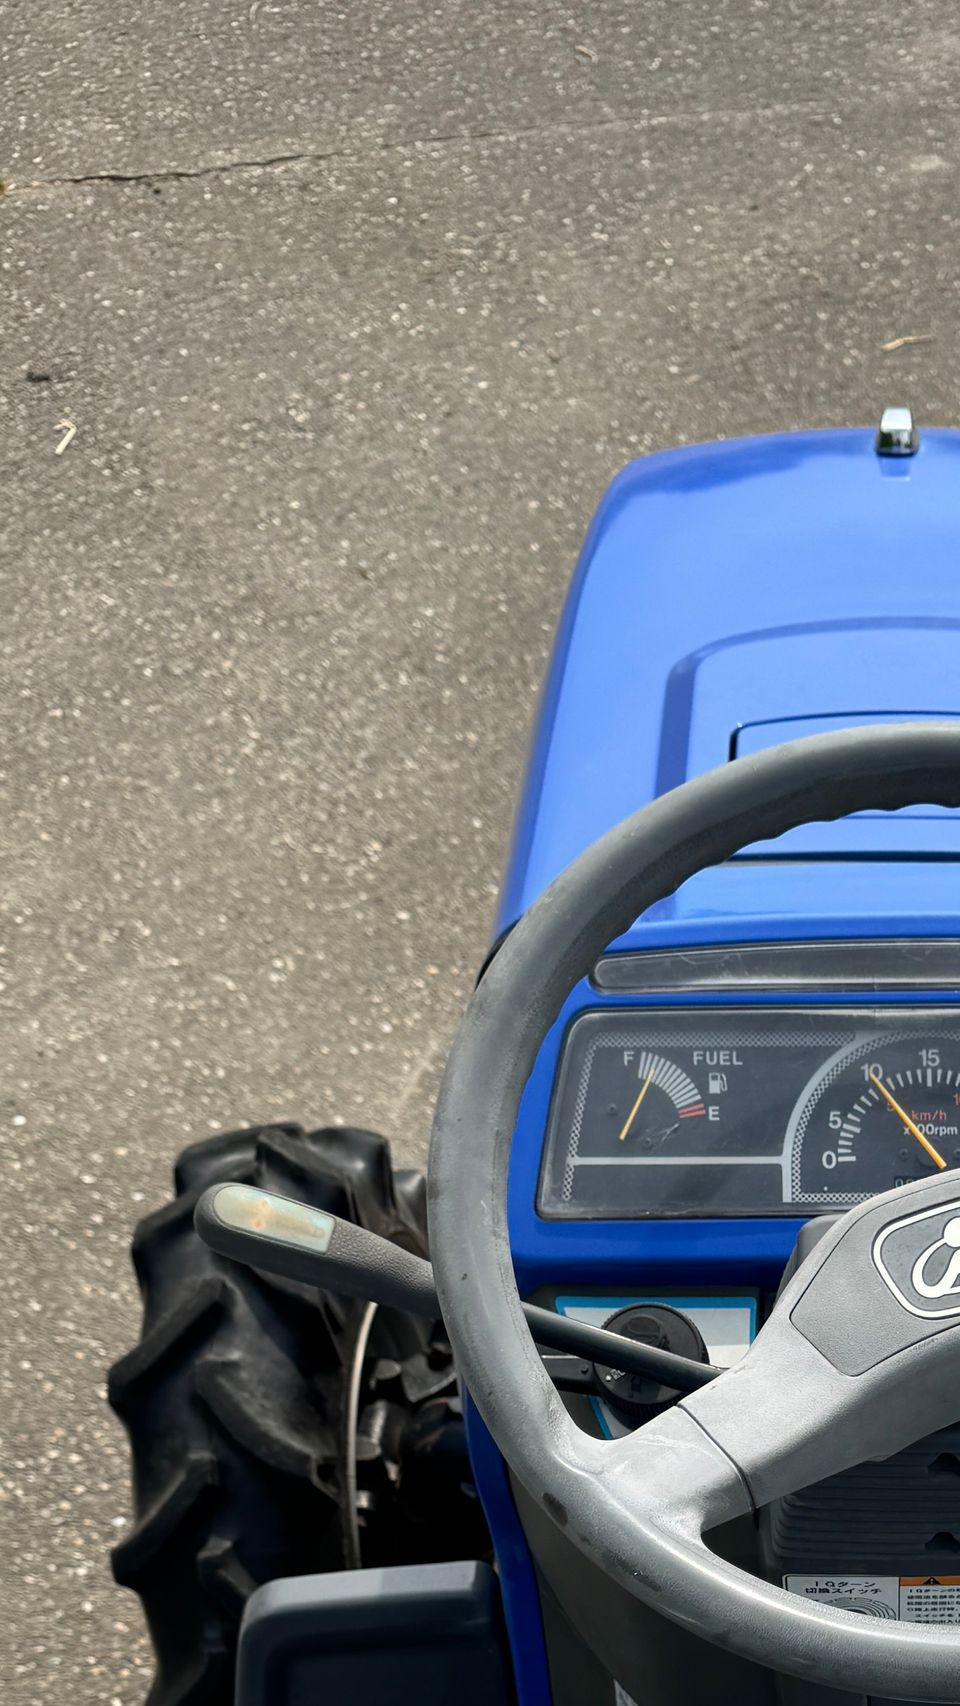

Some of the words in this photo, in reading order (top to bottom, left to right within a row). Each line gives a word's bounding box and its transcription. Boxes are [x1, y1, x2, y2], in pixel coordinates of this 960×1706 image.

[624, 1052, 634, 1066] F
[693, 1051, 743, 1066] FUEL
[919, 1050, 939, 1066] 15
[861, 1063, 883, 1081] 10
[708, 1106, 720, 1121] E
[829, 1111, 842, 1129] 5
[912, 1110, 947, 1121] km/h
[822, 1151, 837, 1169] 0
